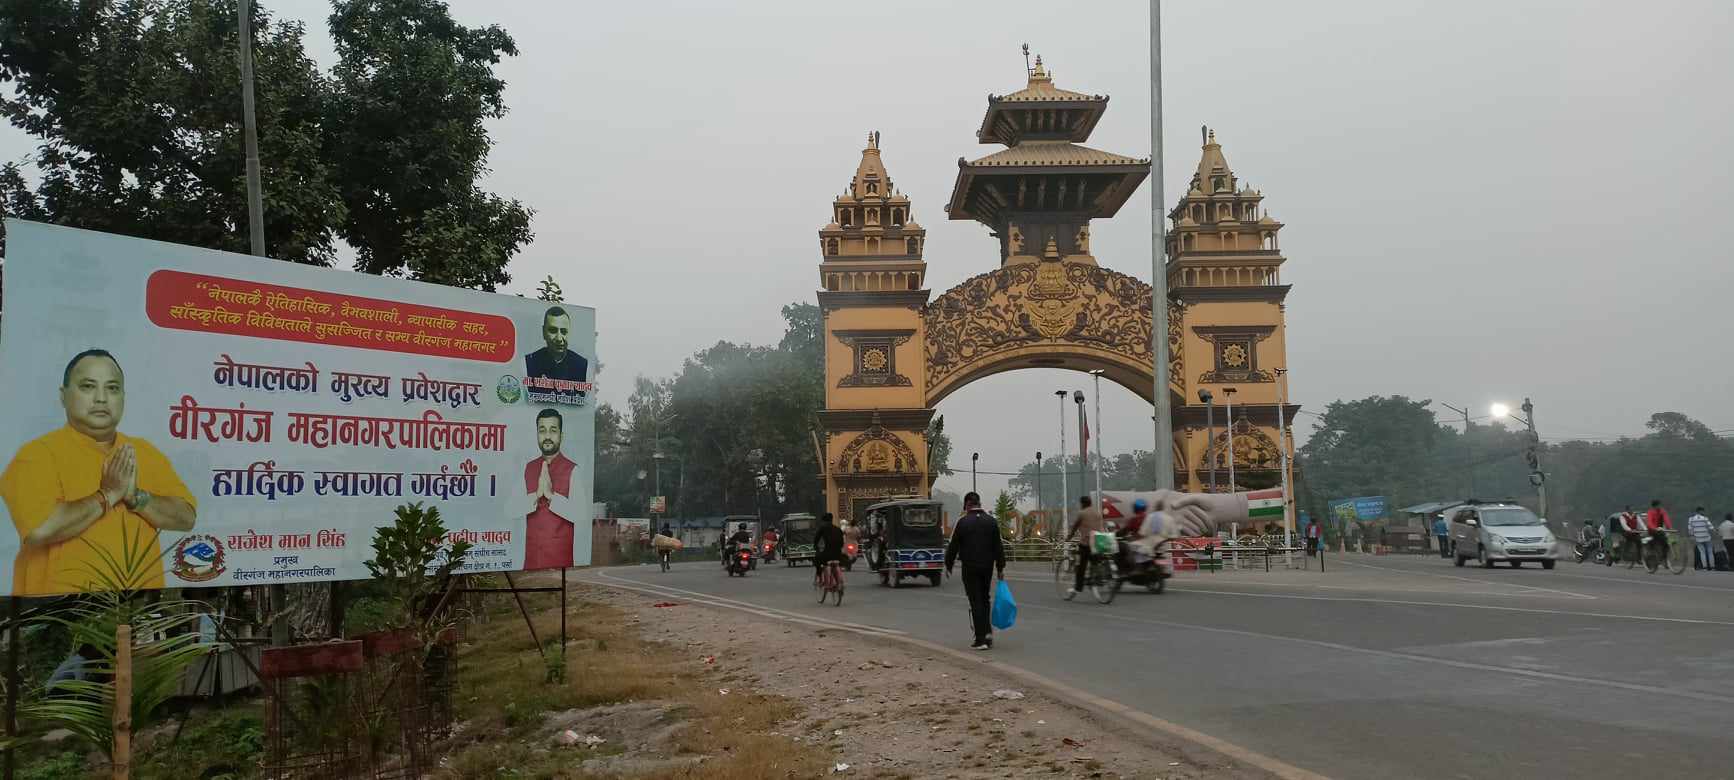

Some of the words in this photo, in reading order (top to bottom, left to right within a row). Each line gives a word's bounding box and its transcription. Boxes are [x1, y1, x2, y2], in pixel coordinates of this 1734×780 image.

[265, 291, 336, 317] ऐतिहासिक,
[340, 301, 403, 326] वैभवशाली,
[246, 310, 313, 333] विविधताले
[315, 321, 373, 340] सुसज्जित
[374, 329, 384, 341] र
[385, 329, 412, 344] सभ्य
[412, 330, 451, 348] वीरगंज
[214, 354, 319, 393] नेपालको
[331, 371, 391, 402] मुख्य
[401, 371, 481, 408] प्रवेशद्वार
[169, 395, 274, 443] वीरगंज
[288, 410, 507, 452] महानगरपालिकामा
[211, 460, 305, 500] हार्दिक
[314, 470, 403, 497] स्वागत
[227, 529, 274, 549] राजेश
[278, 533, 312, 550] मान
[232, 567, 266, 581] वीरगंज
[268, 565, 336, 580] महानगरपालिका
[272, 554, 299, 569] प्रमुख
